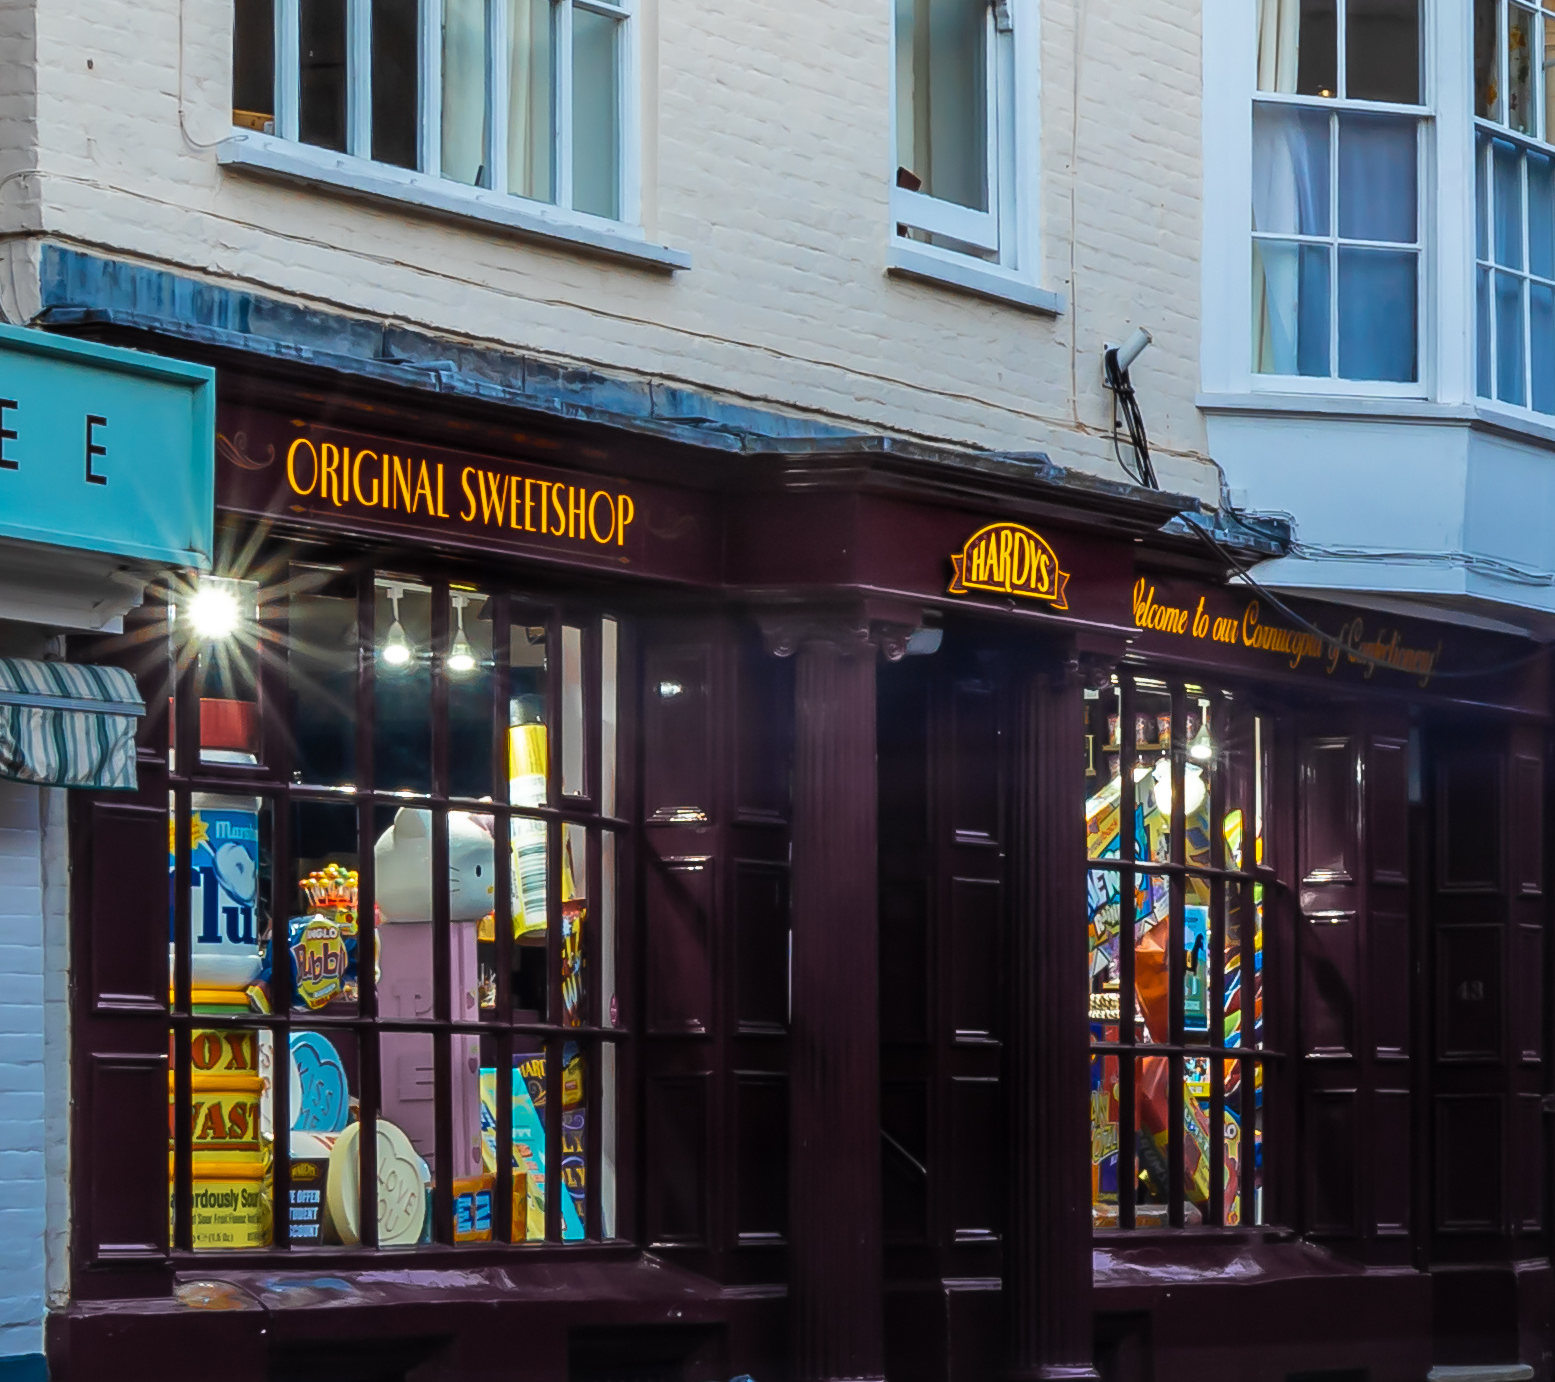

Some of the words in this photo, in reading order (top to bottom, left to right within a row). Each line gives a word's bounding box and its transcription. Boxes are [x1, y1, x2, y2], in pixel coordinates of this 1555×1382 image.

[287, 438, 449, 519] ORIGINAL
[460, 466, 634, 546] SWEETSHOP
[971, 529, 1050, 593] HARDYS
[1192, 596, 1210, 638] to
[1212, 616, 1238, 645] our
